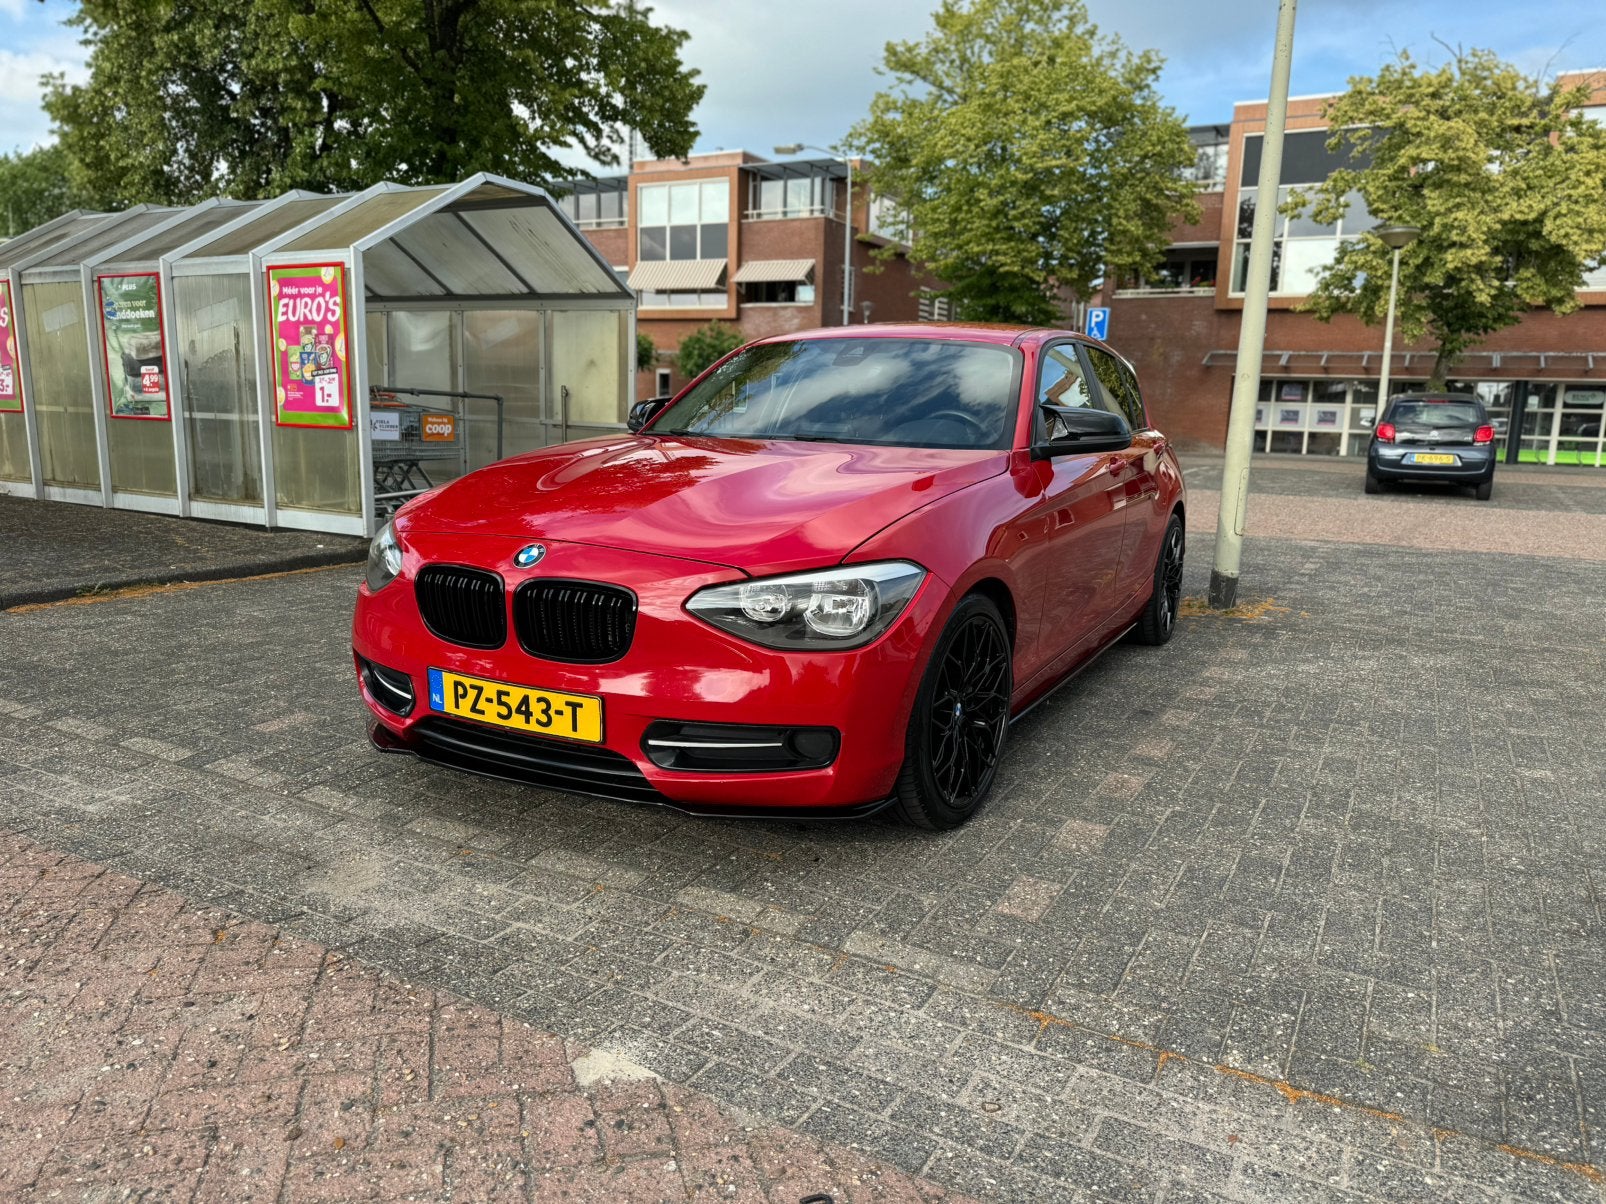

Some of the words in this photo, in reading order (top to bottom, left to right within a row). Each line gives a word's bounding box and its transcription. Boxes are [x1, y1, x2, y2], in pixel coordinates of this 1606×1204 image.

[282, 285, 299, 295] Méér
[300, 286, 315, 294] voor
[315, 284, 323, 295] je
[277, 291, 340, 322] EURO'S
[1090, 310, 1105, 328] P
[426, 424, 452, 437] coop
[432, 693, 443, 704] NL
[453, 680, 584, 733] PZ-543-T
